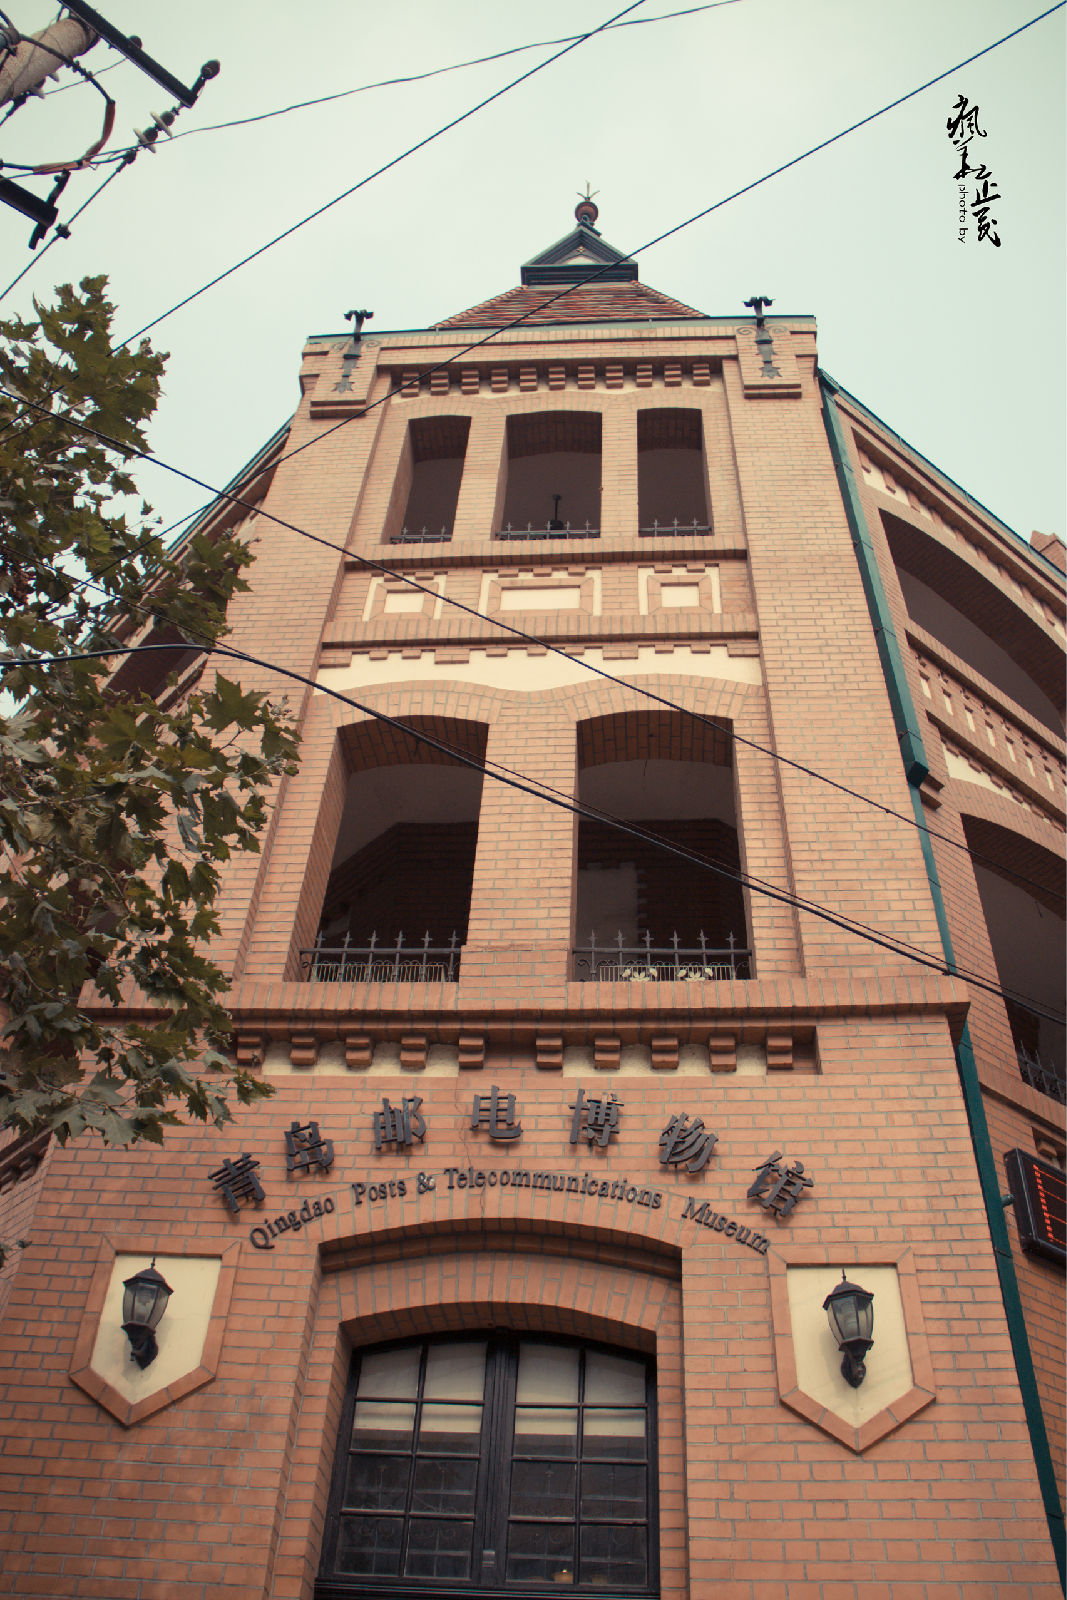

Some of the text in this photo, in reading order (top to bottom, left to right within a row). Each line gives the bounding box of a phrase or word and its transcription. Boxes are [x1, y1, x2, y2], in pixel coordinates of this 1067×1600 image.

[207, 1084, 814, 1218] 青岛邮电博物馆
[249, 1166, 771, 1256] Qingdao Posts & Telecommunications Museum
